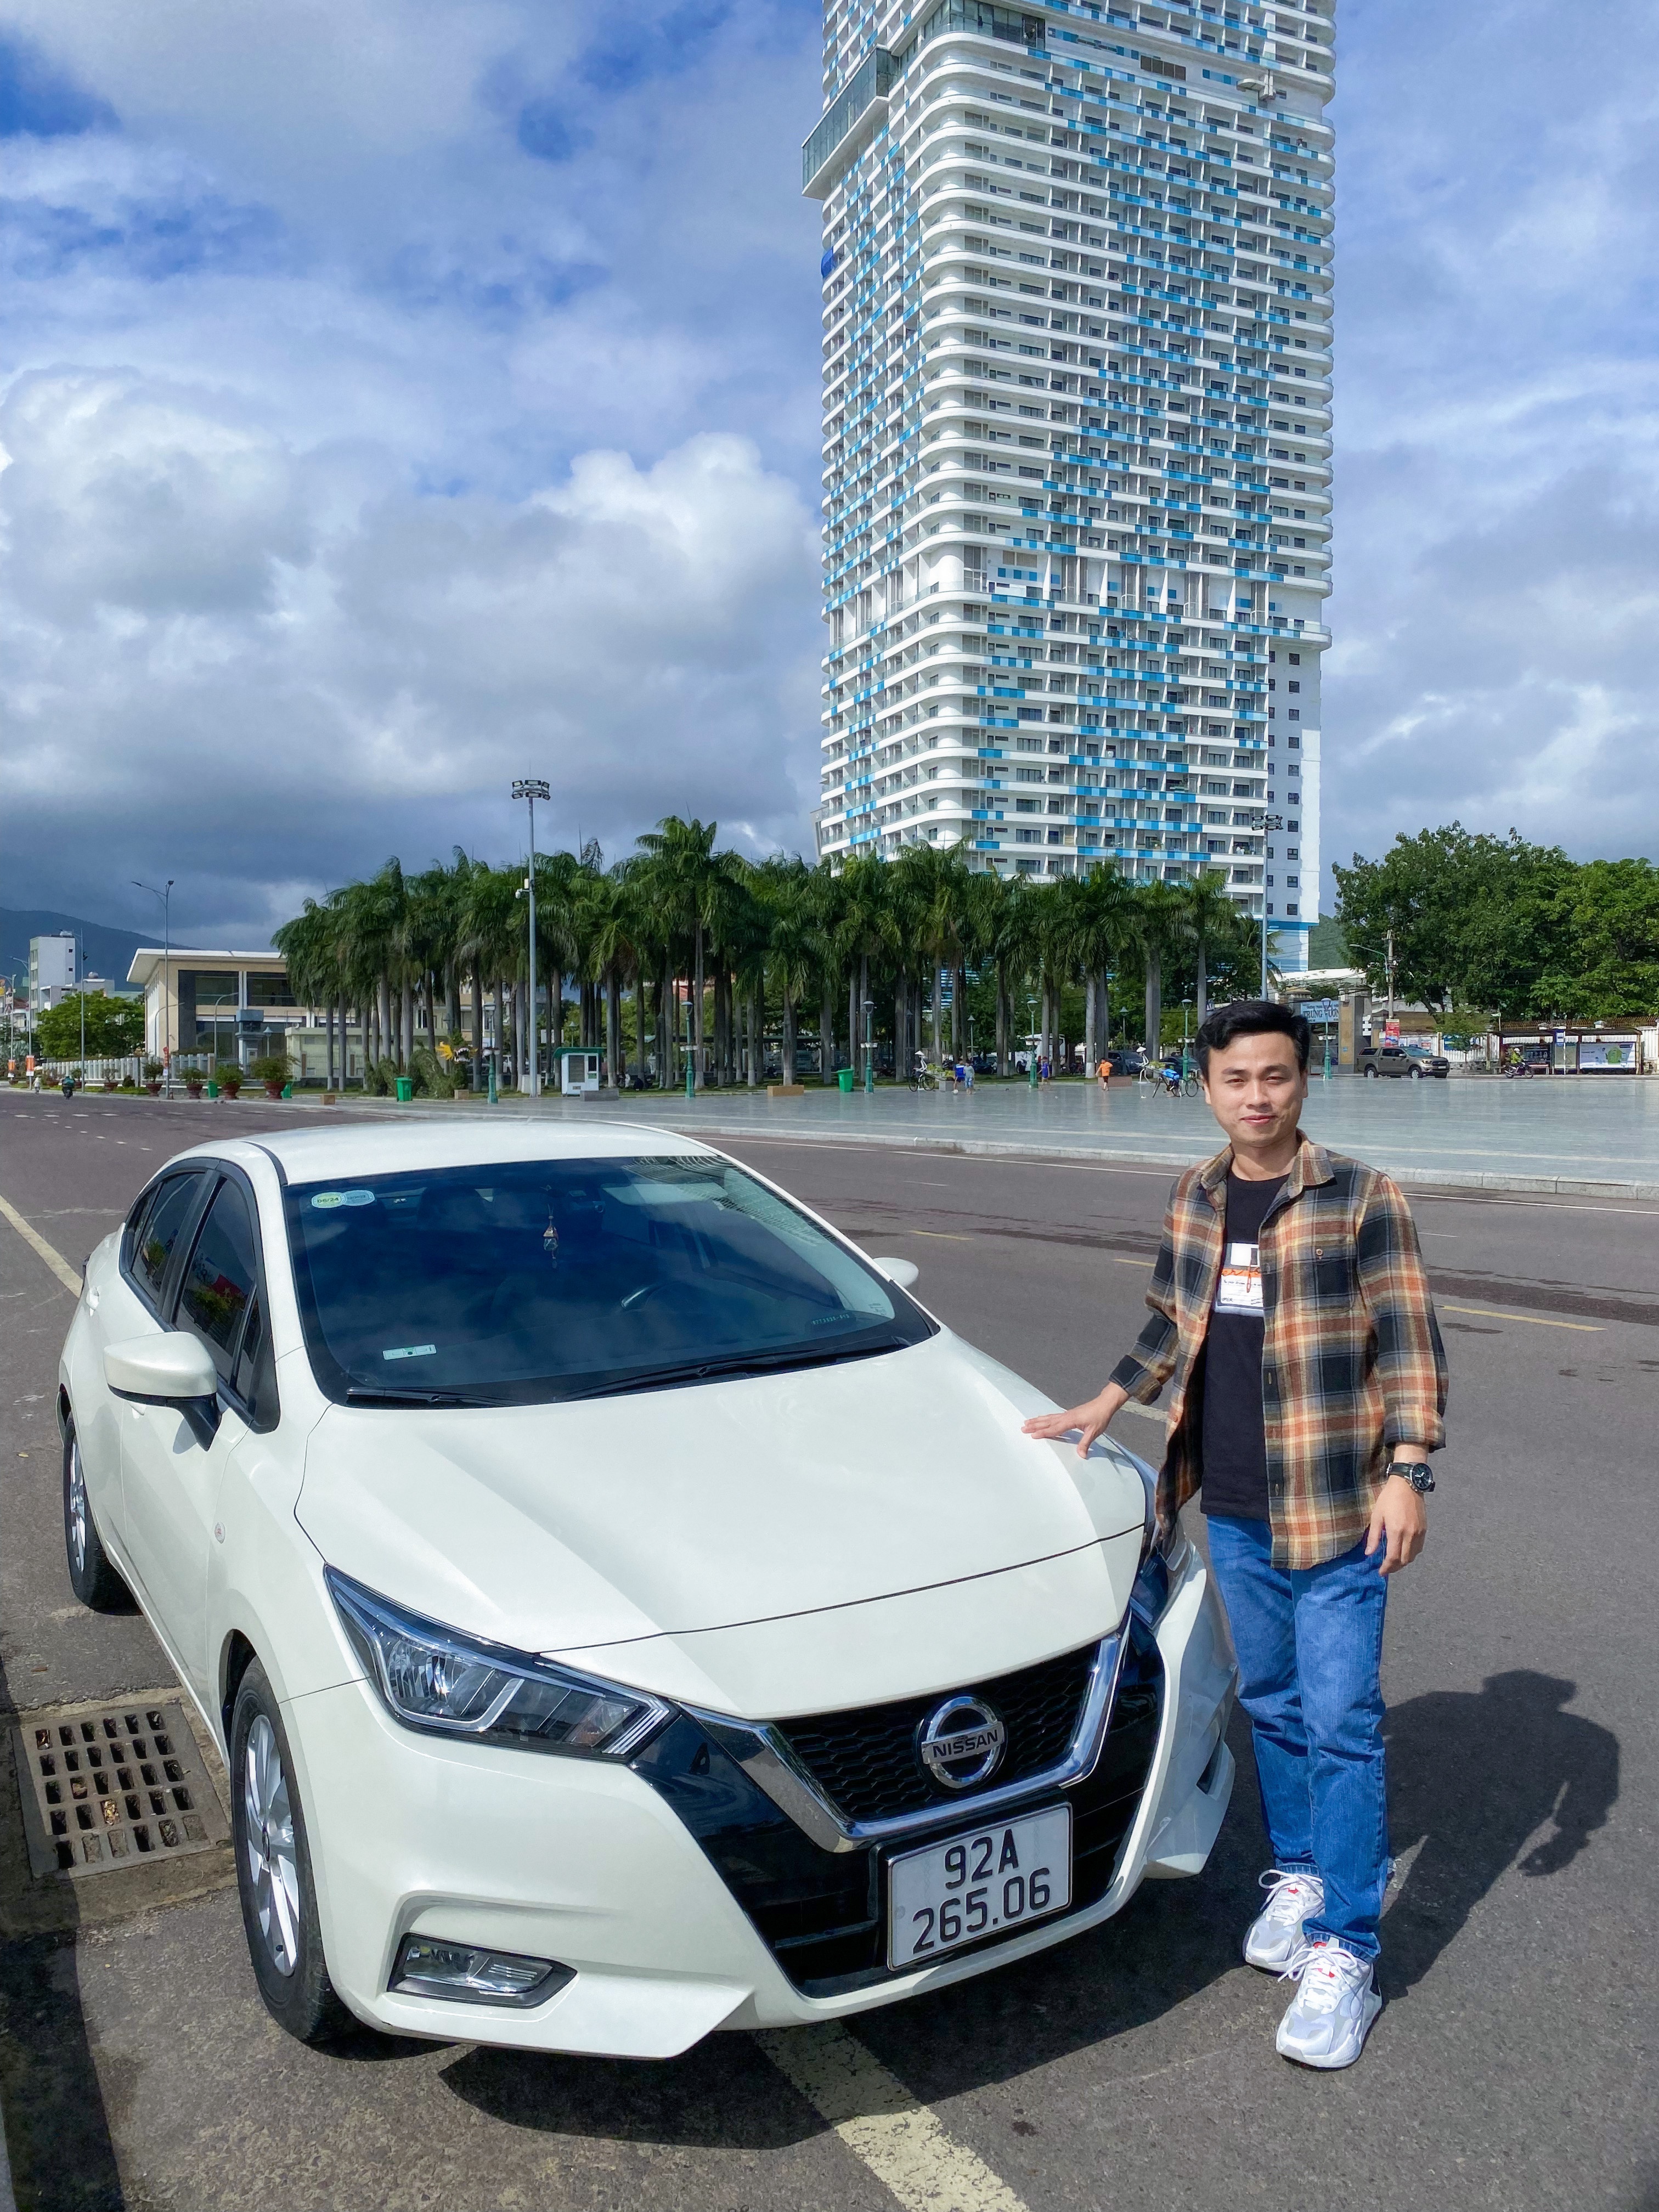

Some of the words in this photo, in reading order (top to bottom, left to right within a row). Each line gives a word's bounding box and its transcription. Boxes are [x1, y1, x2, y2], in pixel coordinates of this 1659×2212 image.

[933, 1729, 998, 1758] NISSAN
[945, 1829, 1019, 1889] 92A
[913, 1867, 1050, 1954] 265.06
